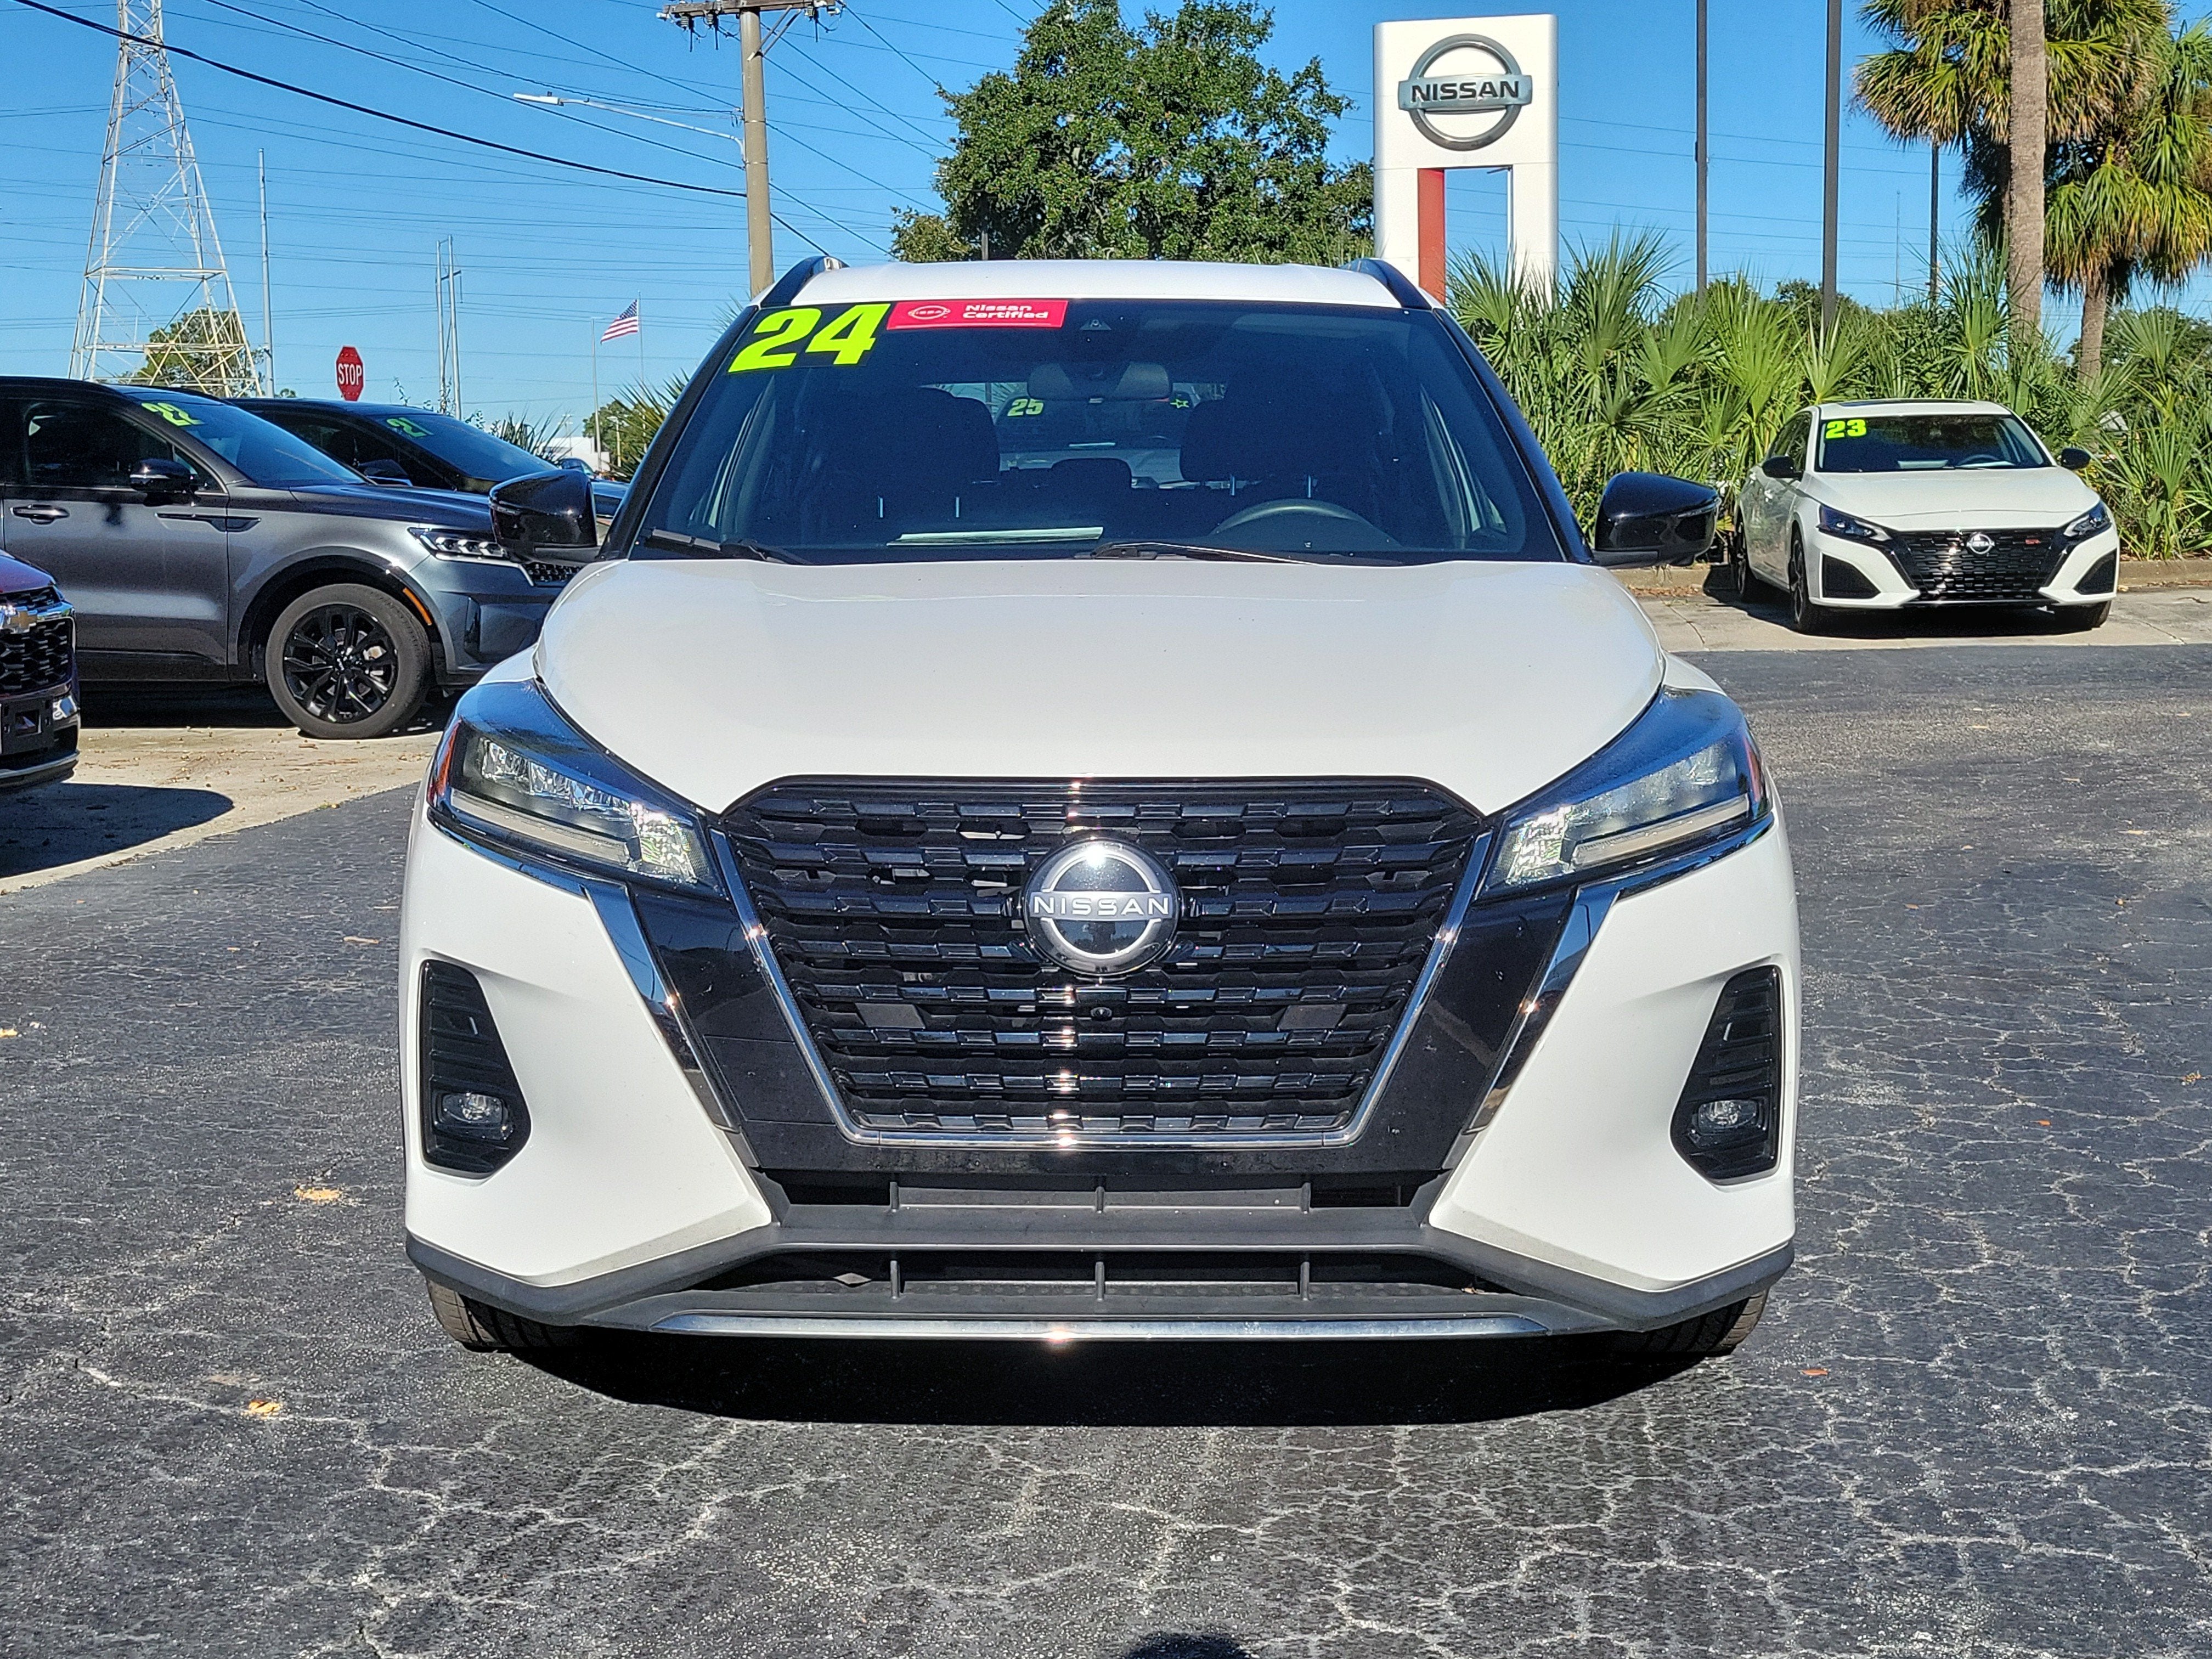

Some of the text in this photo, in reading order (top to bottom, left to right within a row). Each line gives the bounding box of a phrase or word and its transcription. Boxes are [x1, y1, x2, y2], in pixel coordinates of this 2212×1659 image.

[1411, 80, 1520, 103] NISSAN
[728, 303, 891, 373] 24
[337, 363, 362, 385] STOP
[141, 402, 206, 426] 22
[1007, 398, 1044, 416] 25
[386, 417, 435, 437] 21
[1825, 419, 1867, 439] 23
[1033, 896, 1169, 916] NISSAN
